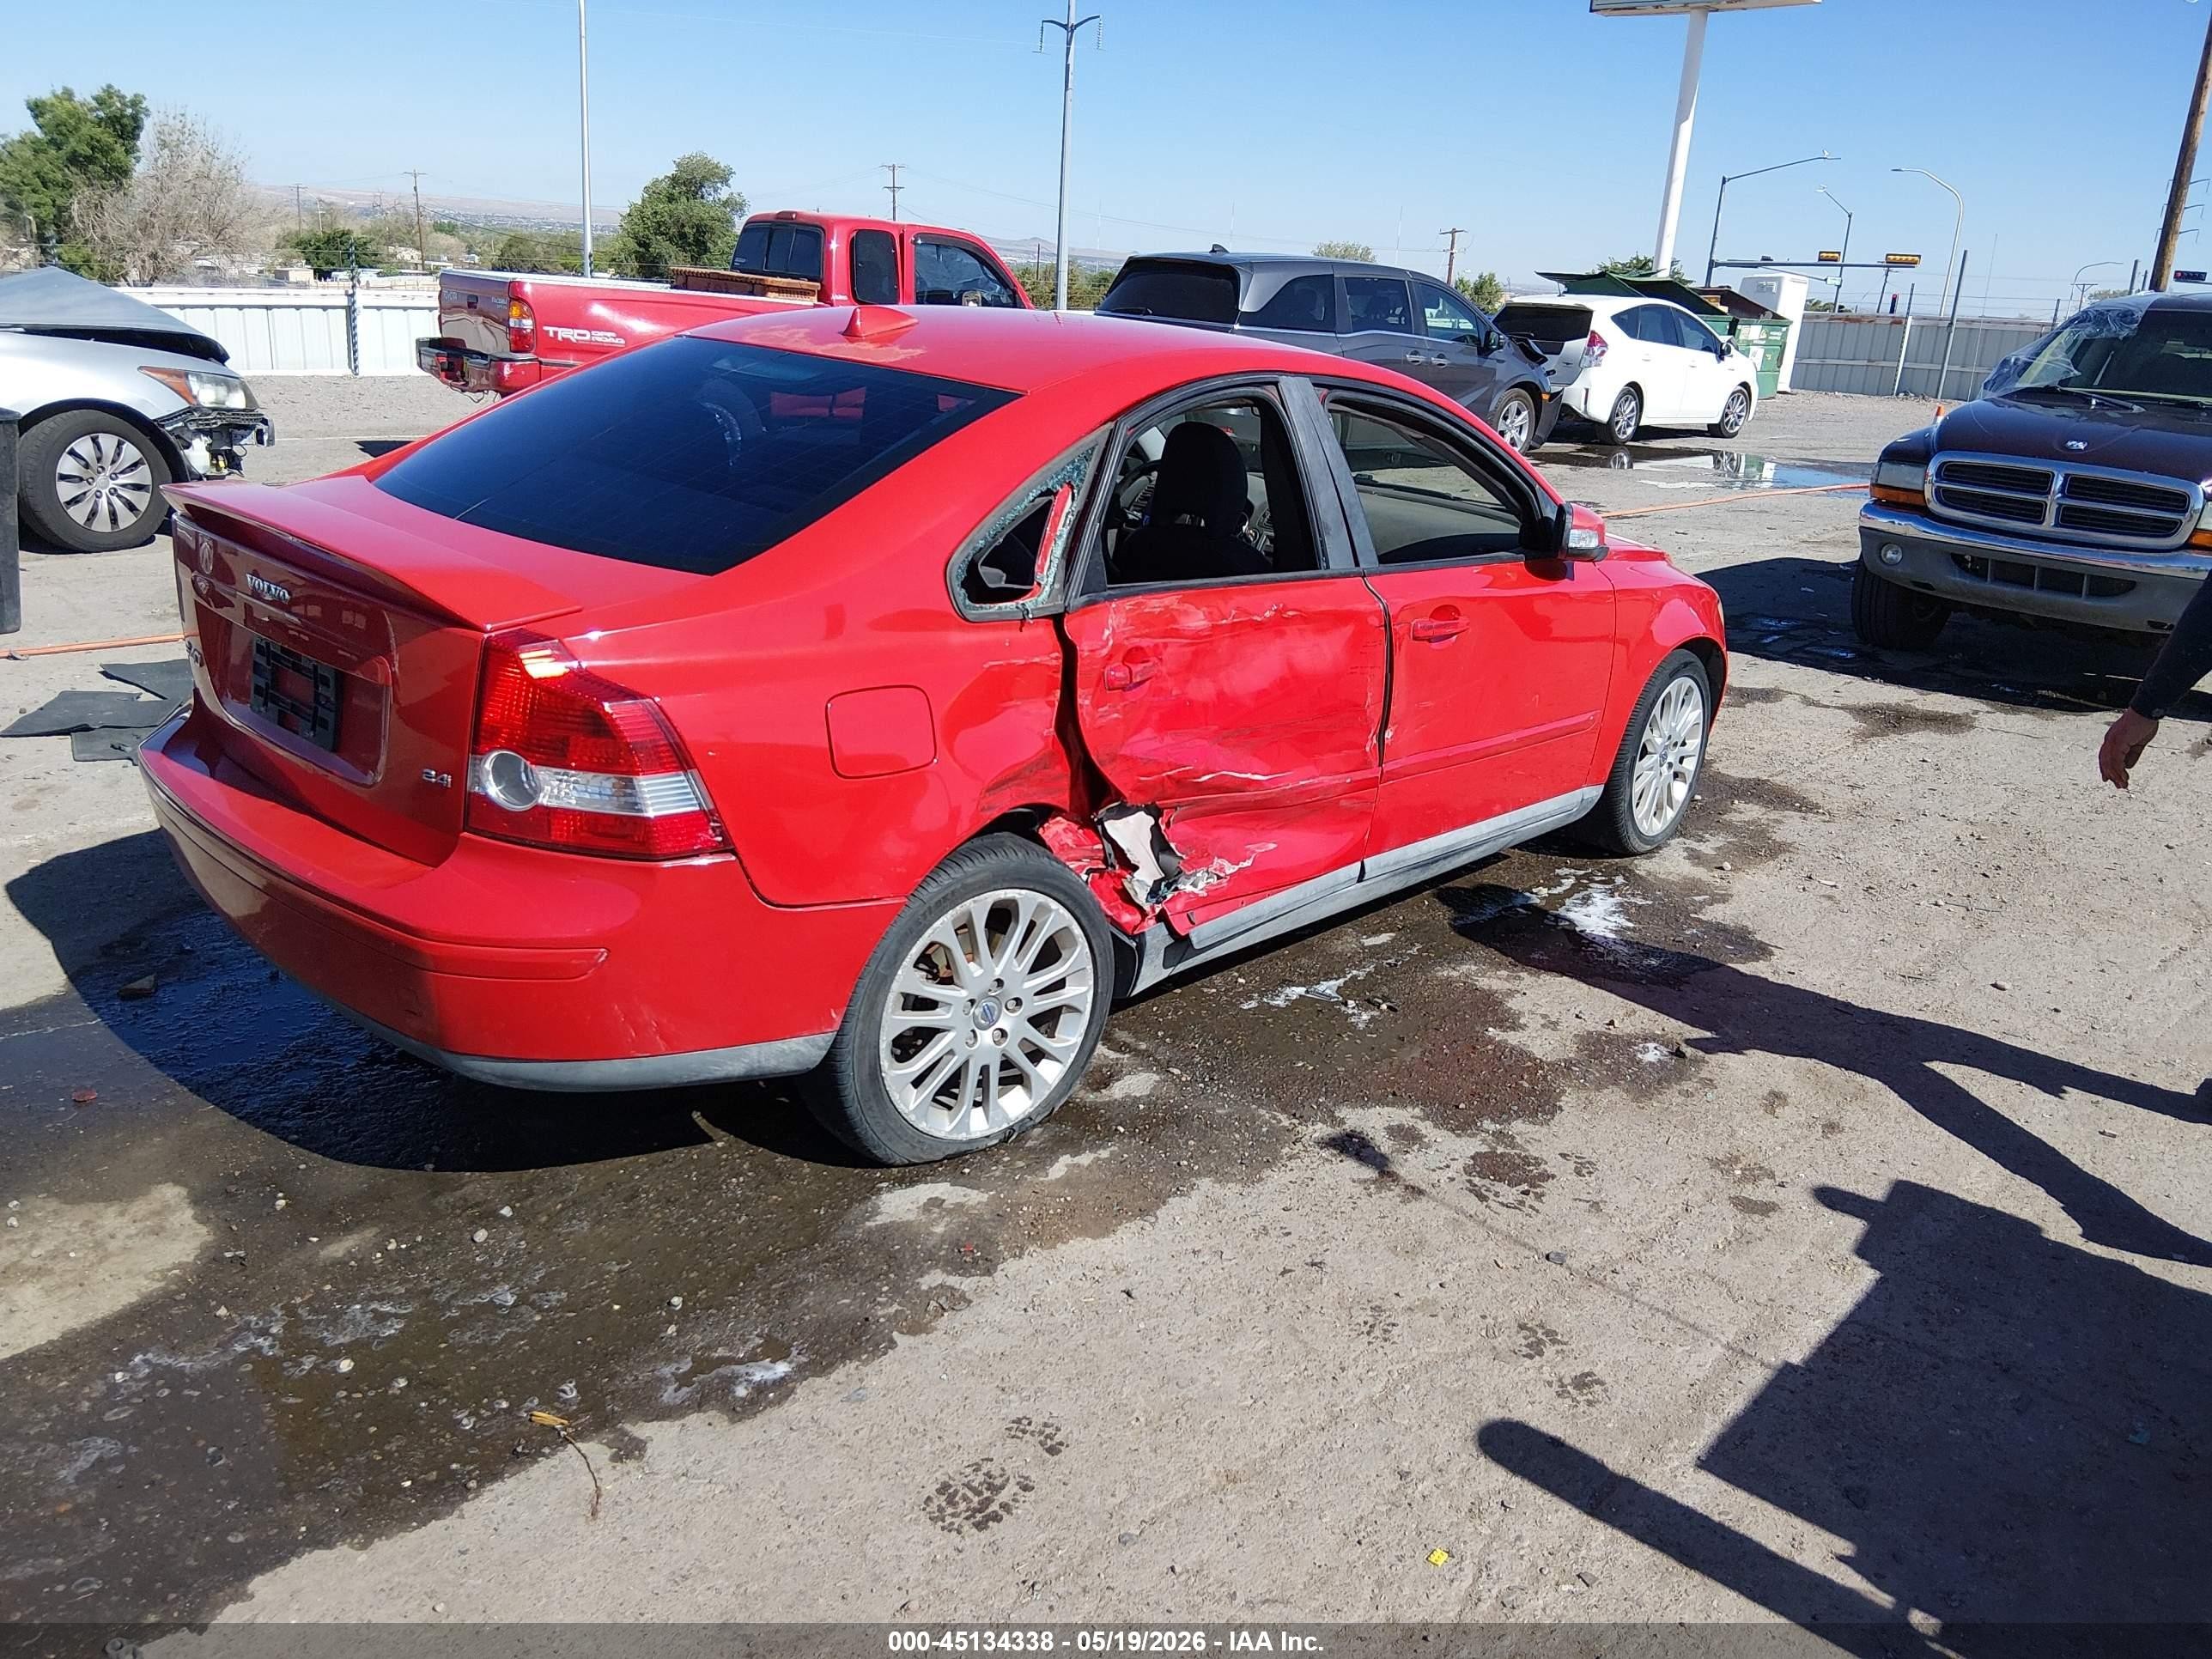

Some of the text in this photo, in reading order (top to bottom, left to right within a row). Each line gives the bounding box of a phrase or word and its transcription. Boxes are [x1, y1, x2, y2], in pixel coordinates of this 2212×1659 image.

[542, 325, 591, 343] TRD
[592, 336, 626, 344] ROAD
[246, 573, 290, 605] VOLVO
